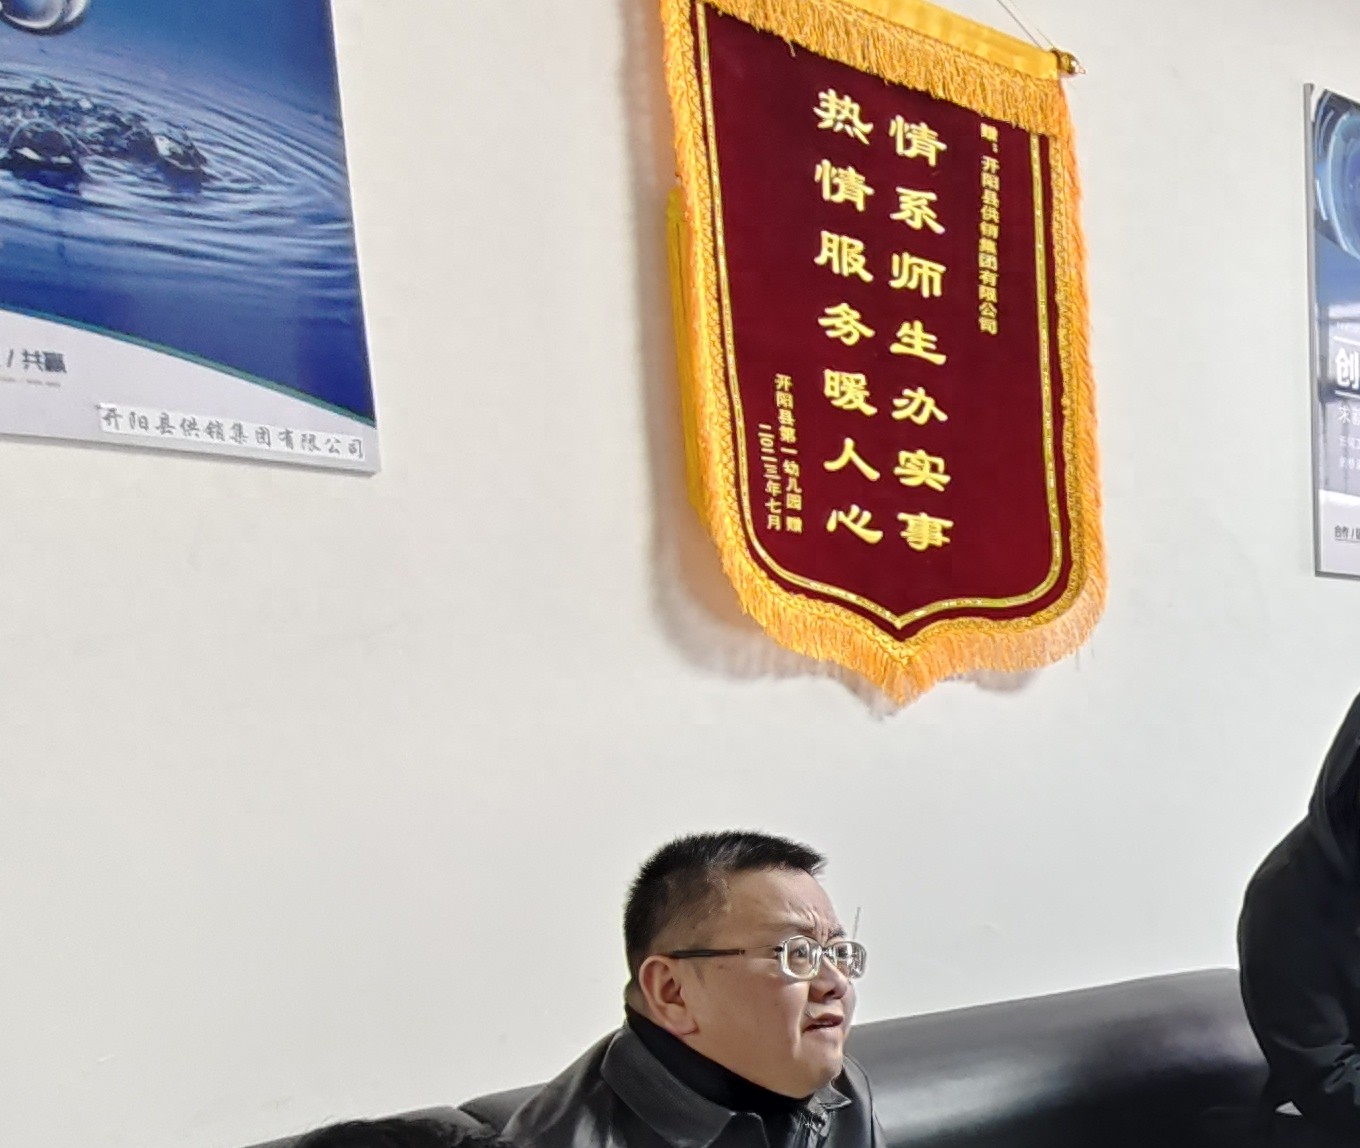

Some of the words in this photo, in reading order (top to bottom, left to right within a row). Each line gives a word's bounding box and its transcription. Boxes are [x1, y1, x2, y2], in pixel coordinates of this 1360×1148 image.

[102, 408, 365, 458] 开阳县供销集团有限公司
[812, 88, 884, 546] 热情服务暖人心
[888, 114, 952, 552] 情系师生办实事
